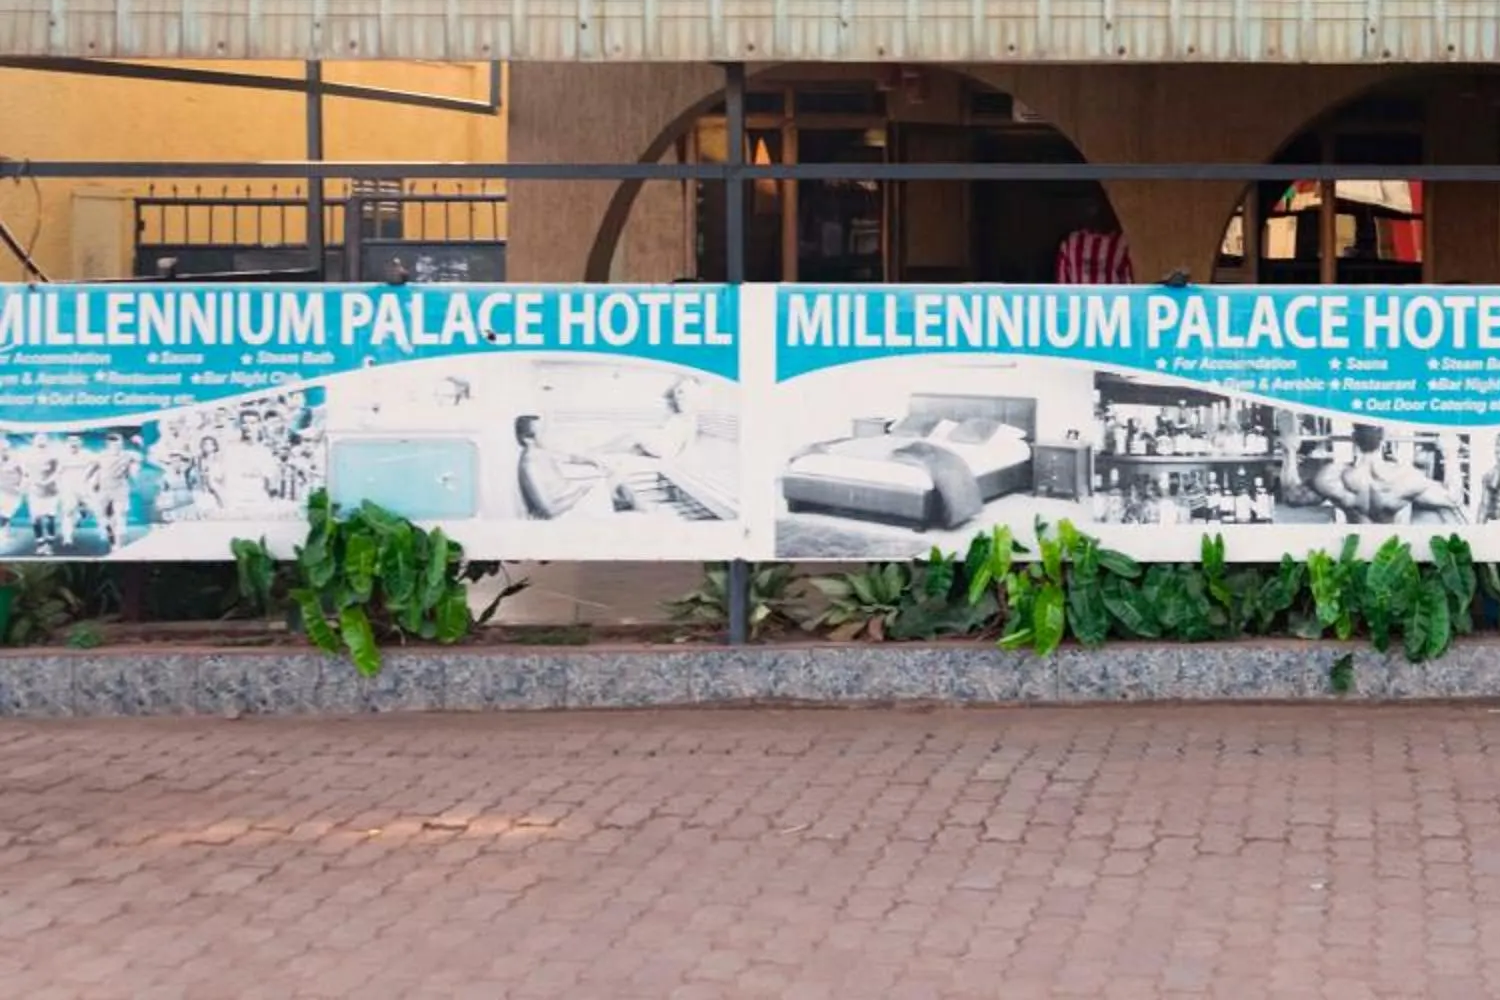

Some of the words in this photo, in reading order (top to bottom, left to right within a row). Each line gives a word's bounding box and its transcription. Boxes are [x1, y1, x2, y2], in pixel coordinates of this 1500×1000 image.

[341, 291, 544, 346] PALACE
[559, 291, 732, 346] HOTEL
[786, 293, 1132, 347] MILLENNIUM
[1147, 294, 1349, 349] PALACE
[1174, 356, 1198, 371] For
[1346, 357, 1388, 371] Sauna
[1441, 357, 1484, 371] Steam
[1343, 377, 1416, 391] Restaurant
[1429, 398, 1488, 414] Catering
